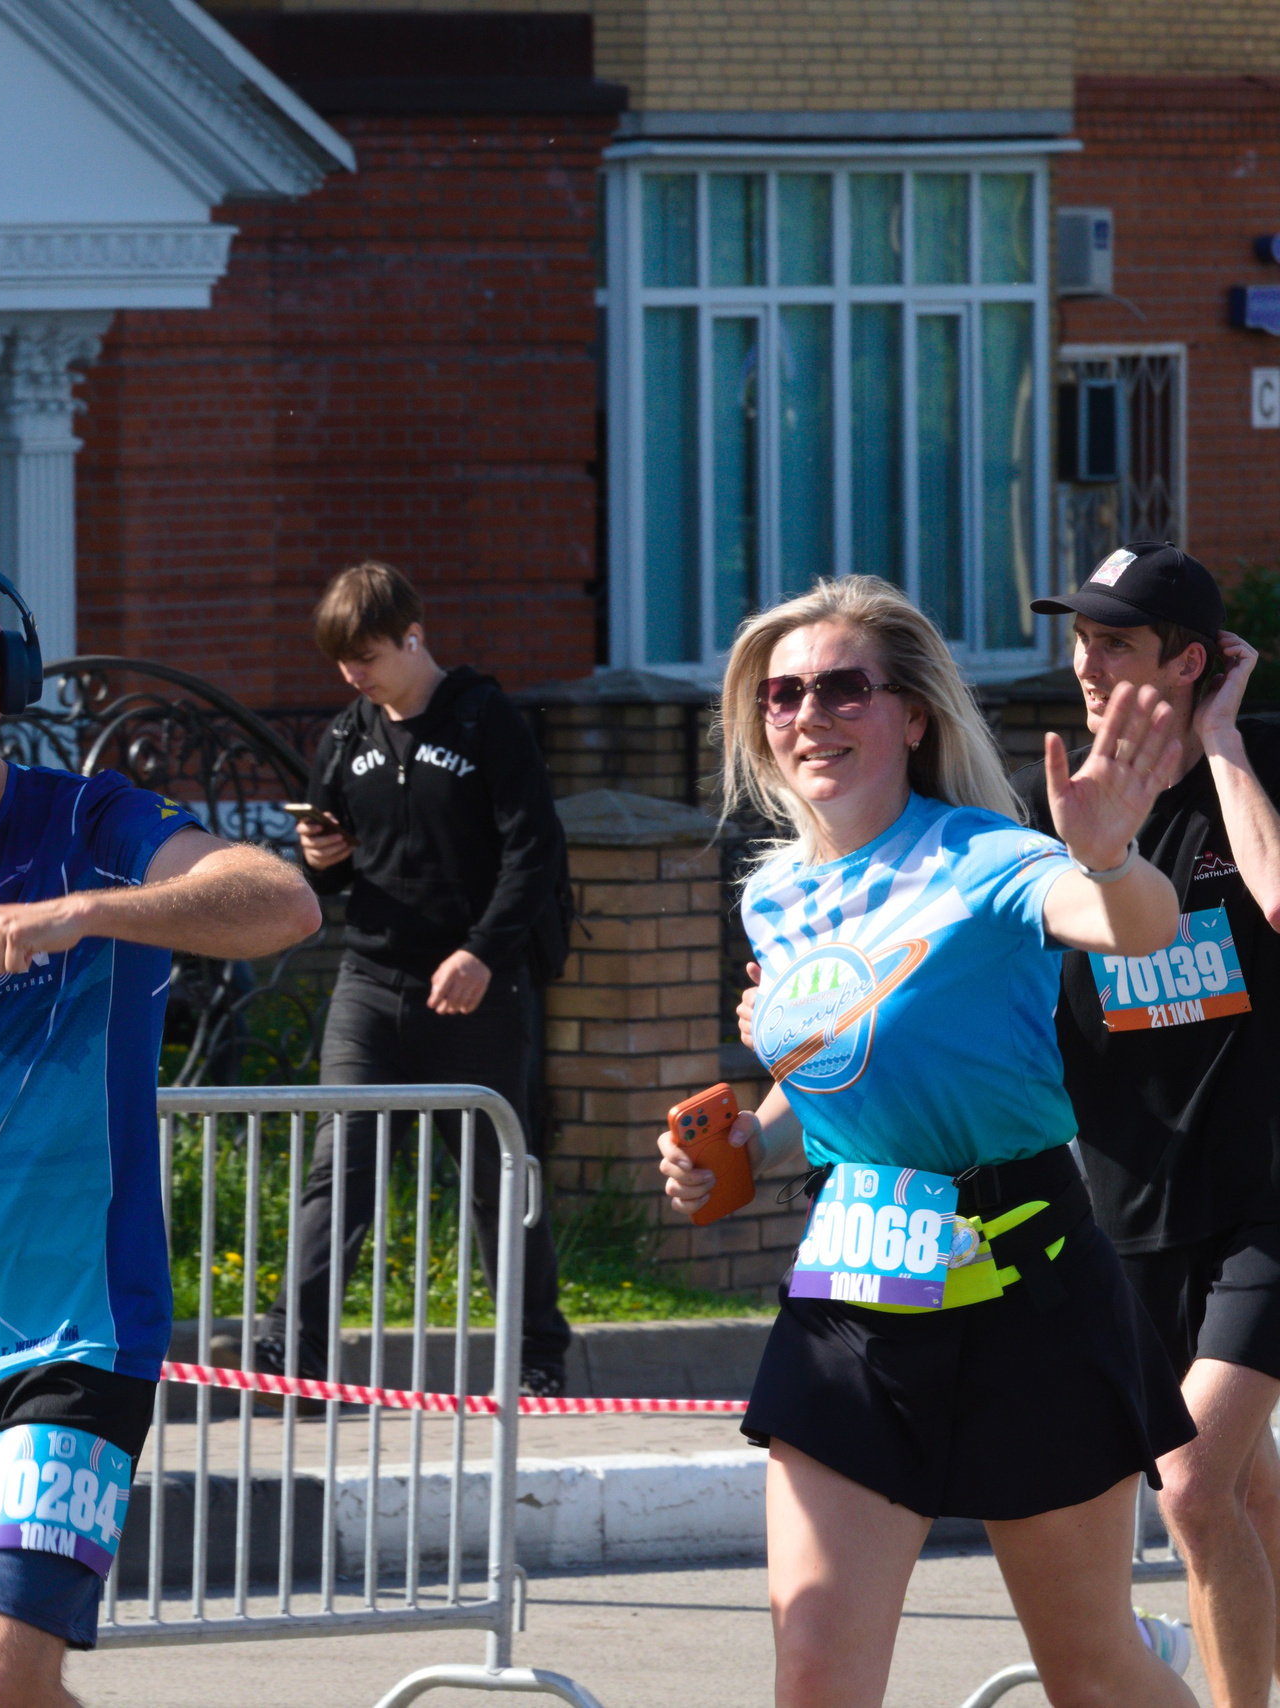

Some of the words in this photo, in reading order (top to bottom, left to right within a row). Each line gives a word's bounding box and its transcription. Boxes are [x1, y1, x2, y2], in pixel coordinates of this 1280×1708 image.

[351, 743, 476, 778] GIVNCHY
[1194, 867, 1238, 881] NORTHLAND
[0, 973, 53, 995] ОМАНДА
[1103, 941, 1229, 1005] 70139
[1148, 999, 1205, 1028] 21.1KM
[853, 1169, 879, 1198] 10
[830, 1272, 881, 1303] 10KM
[48, 1431, 76, 1458] 10
[20, 1521, 77, 1558] 10KM
